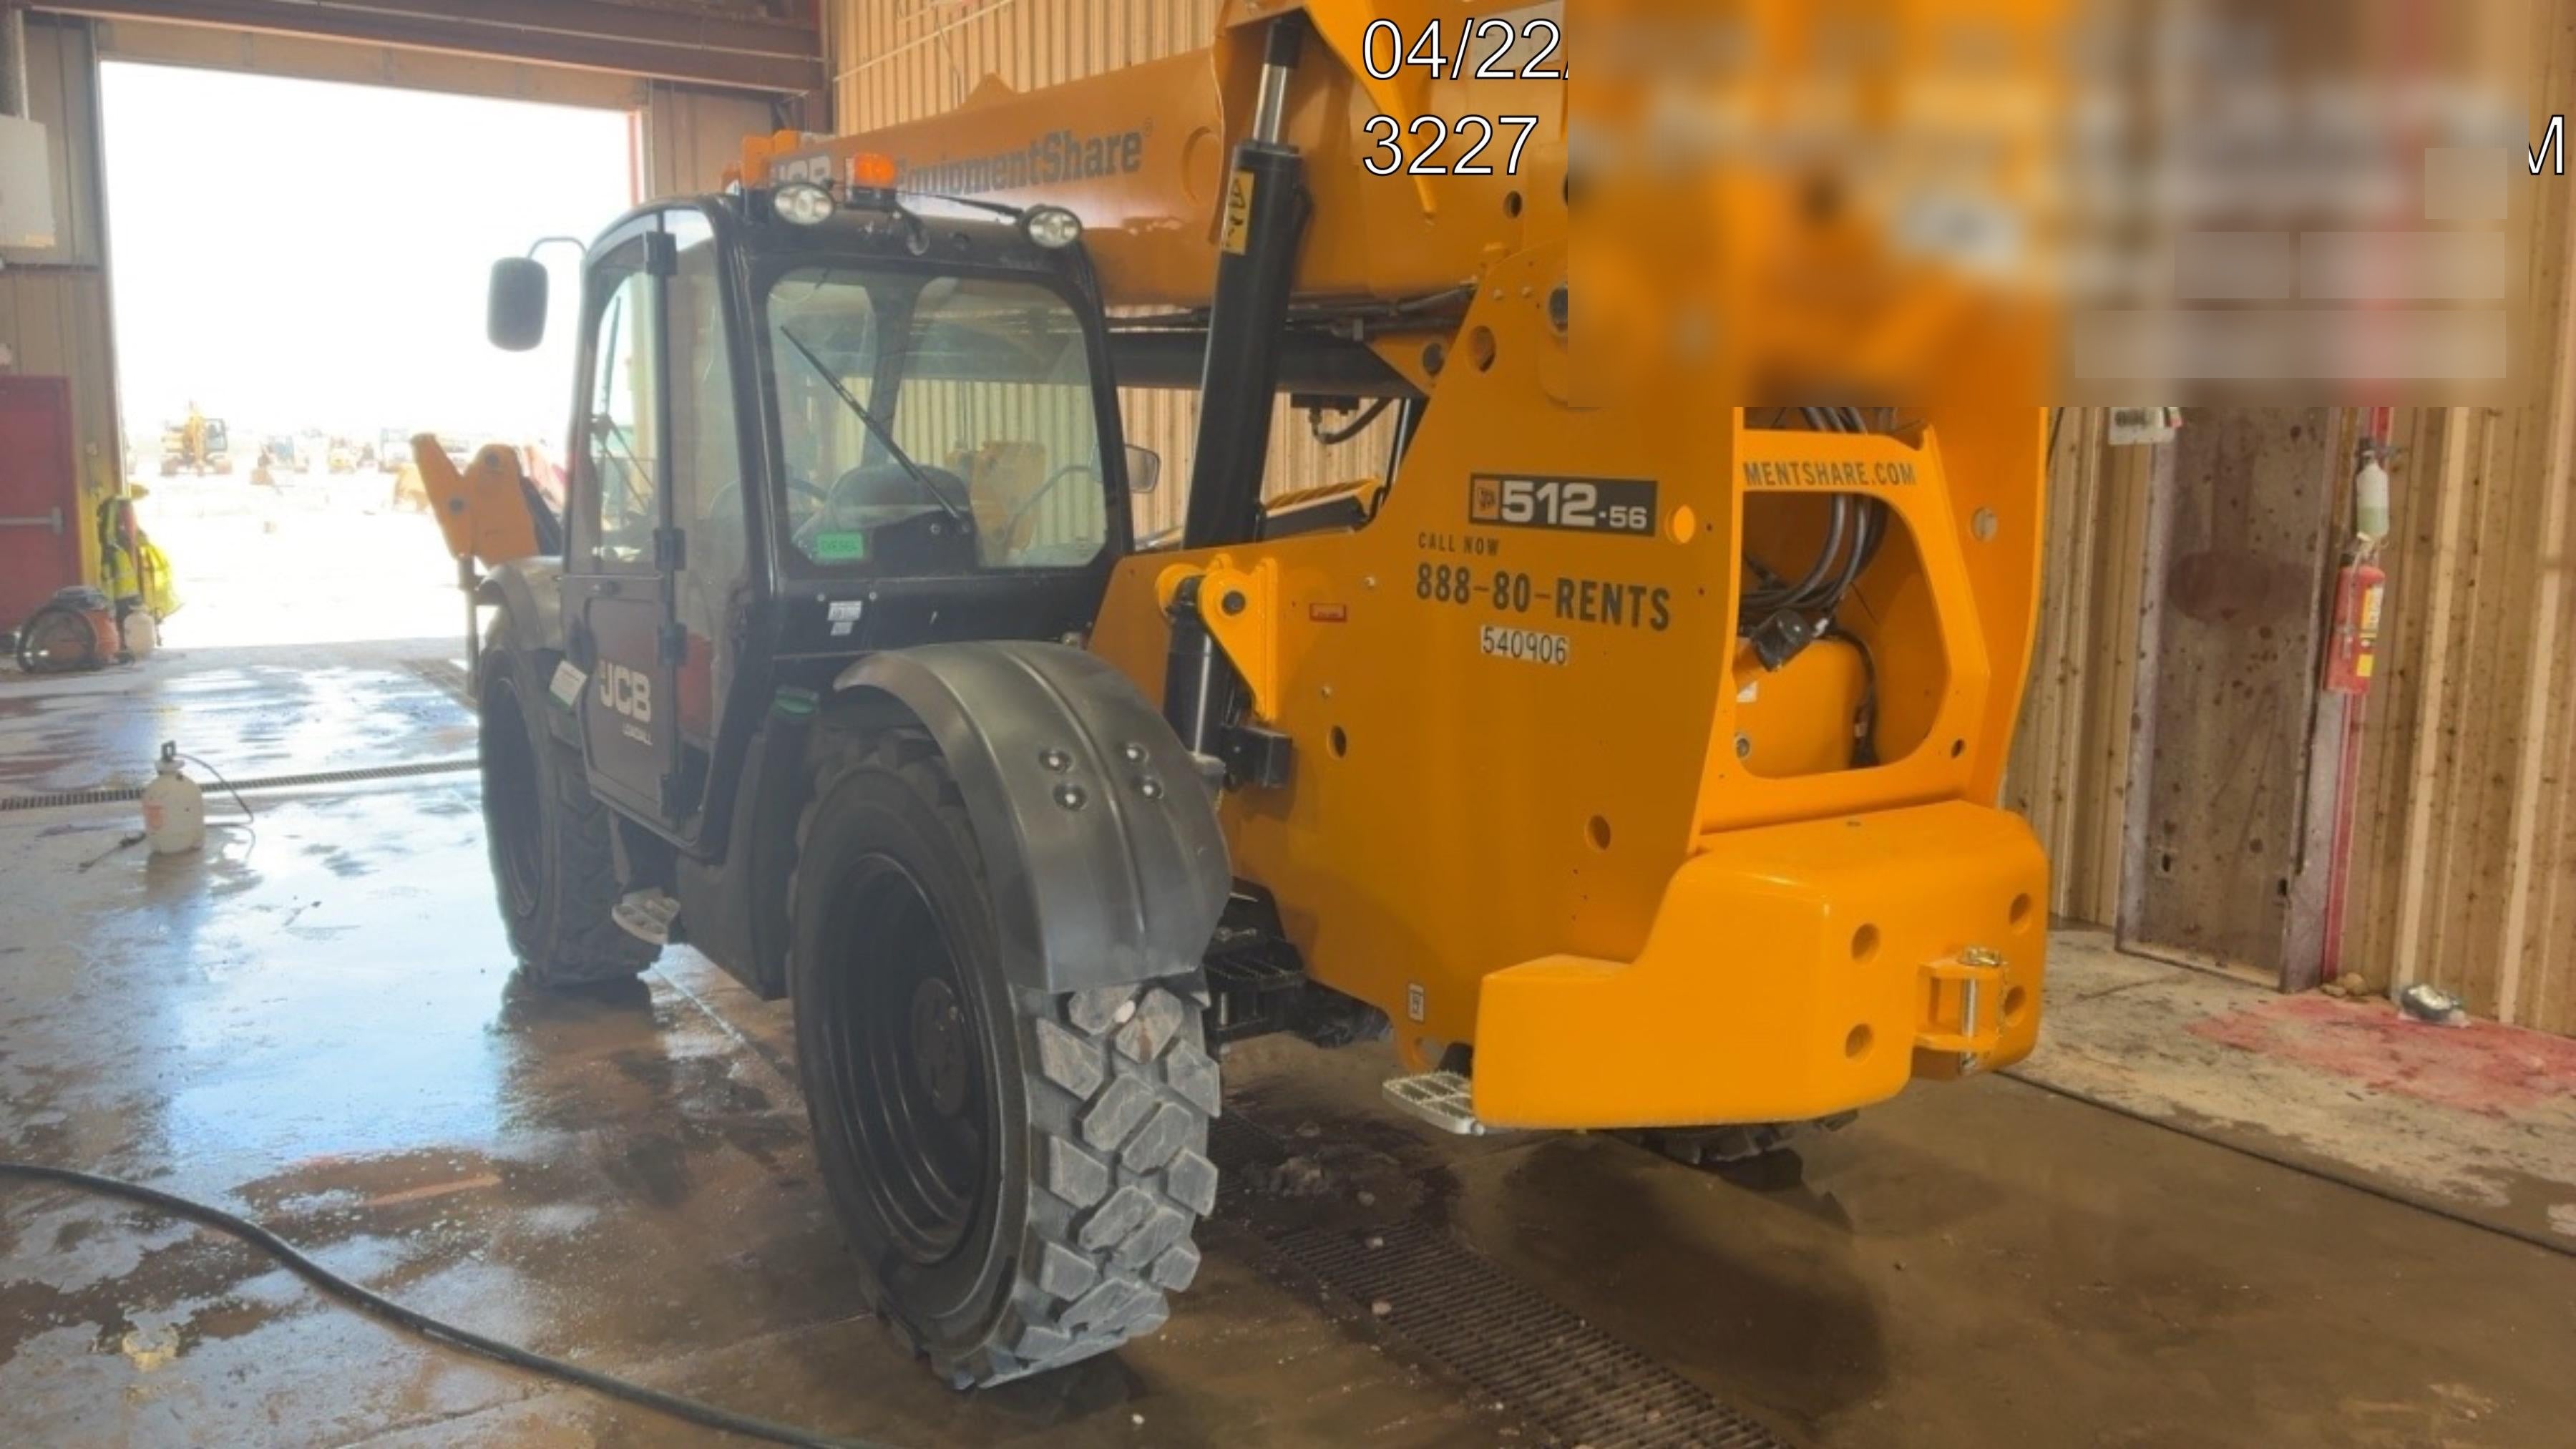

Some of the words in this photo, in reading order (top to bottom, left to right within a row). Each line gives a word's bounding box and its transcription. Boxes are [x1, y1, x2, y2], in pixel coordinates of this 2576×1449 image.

[1418, 532, 1455, 552] CALL
[1464, 536, 1500, 556] NOW
[1416, 562, 1671, 631] 888-80-RENTS
[1483, 626, 1568, 665] 540906
[600, 659, 651, 722] JCB
